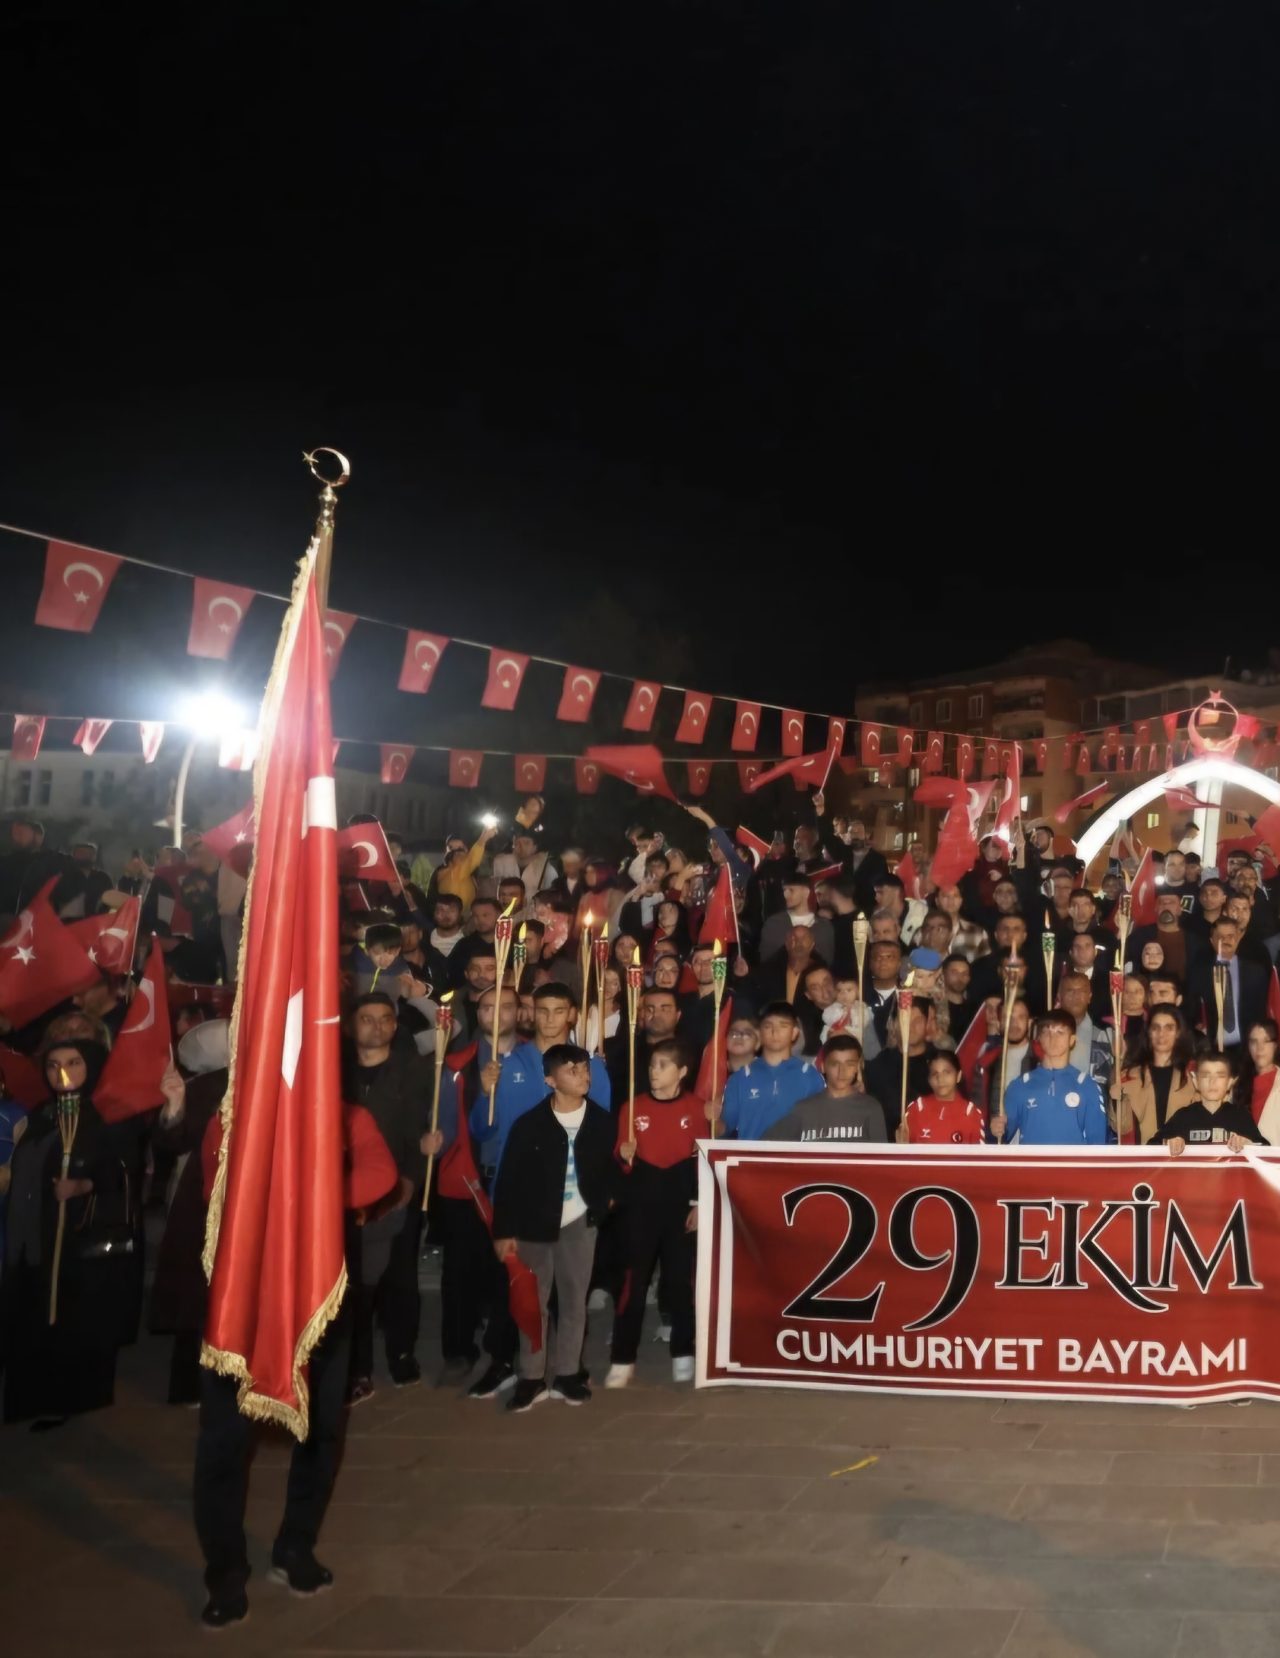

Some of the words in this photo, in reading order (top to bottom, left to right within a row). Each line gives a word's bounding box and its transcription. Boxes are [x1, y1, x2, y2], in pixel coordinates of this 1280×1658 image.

[781, 1182, 981, 1332] 29
[995, 1182, 1264, 1313] EKİM
[1058, 1337, 1247, 1377] BAYRAMI
